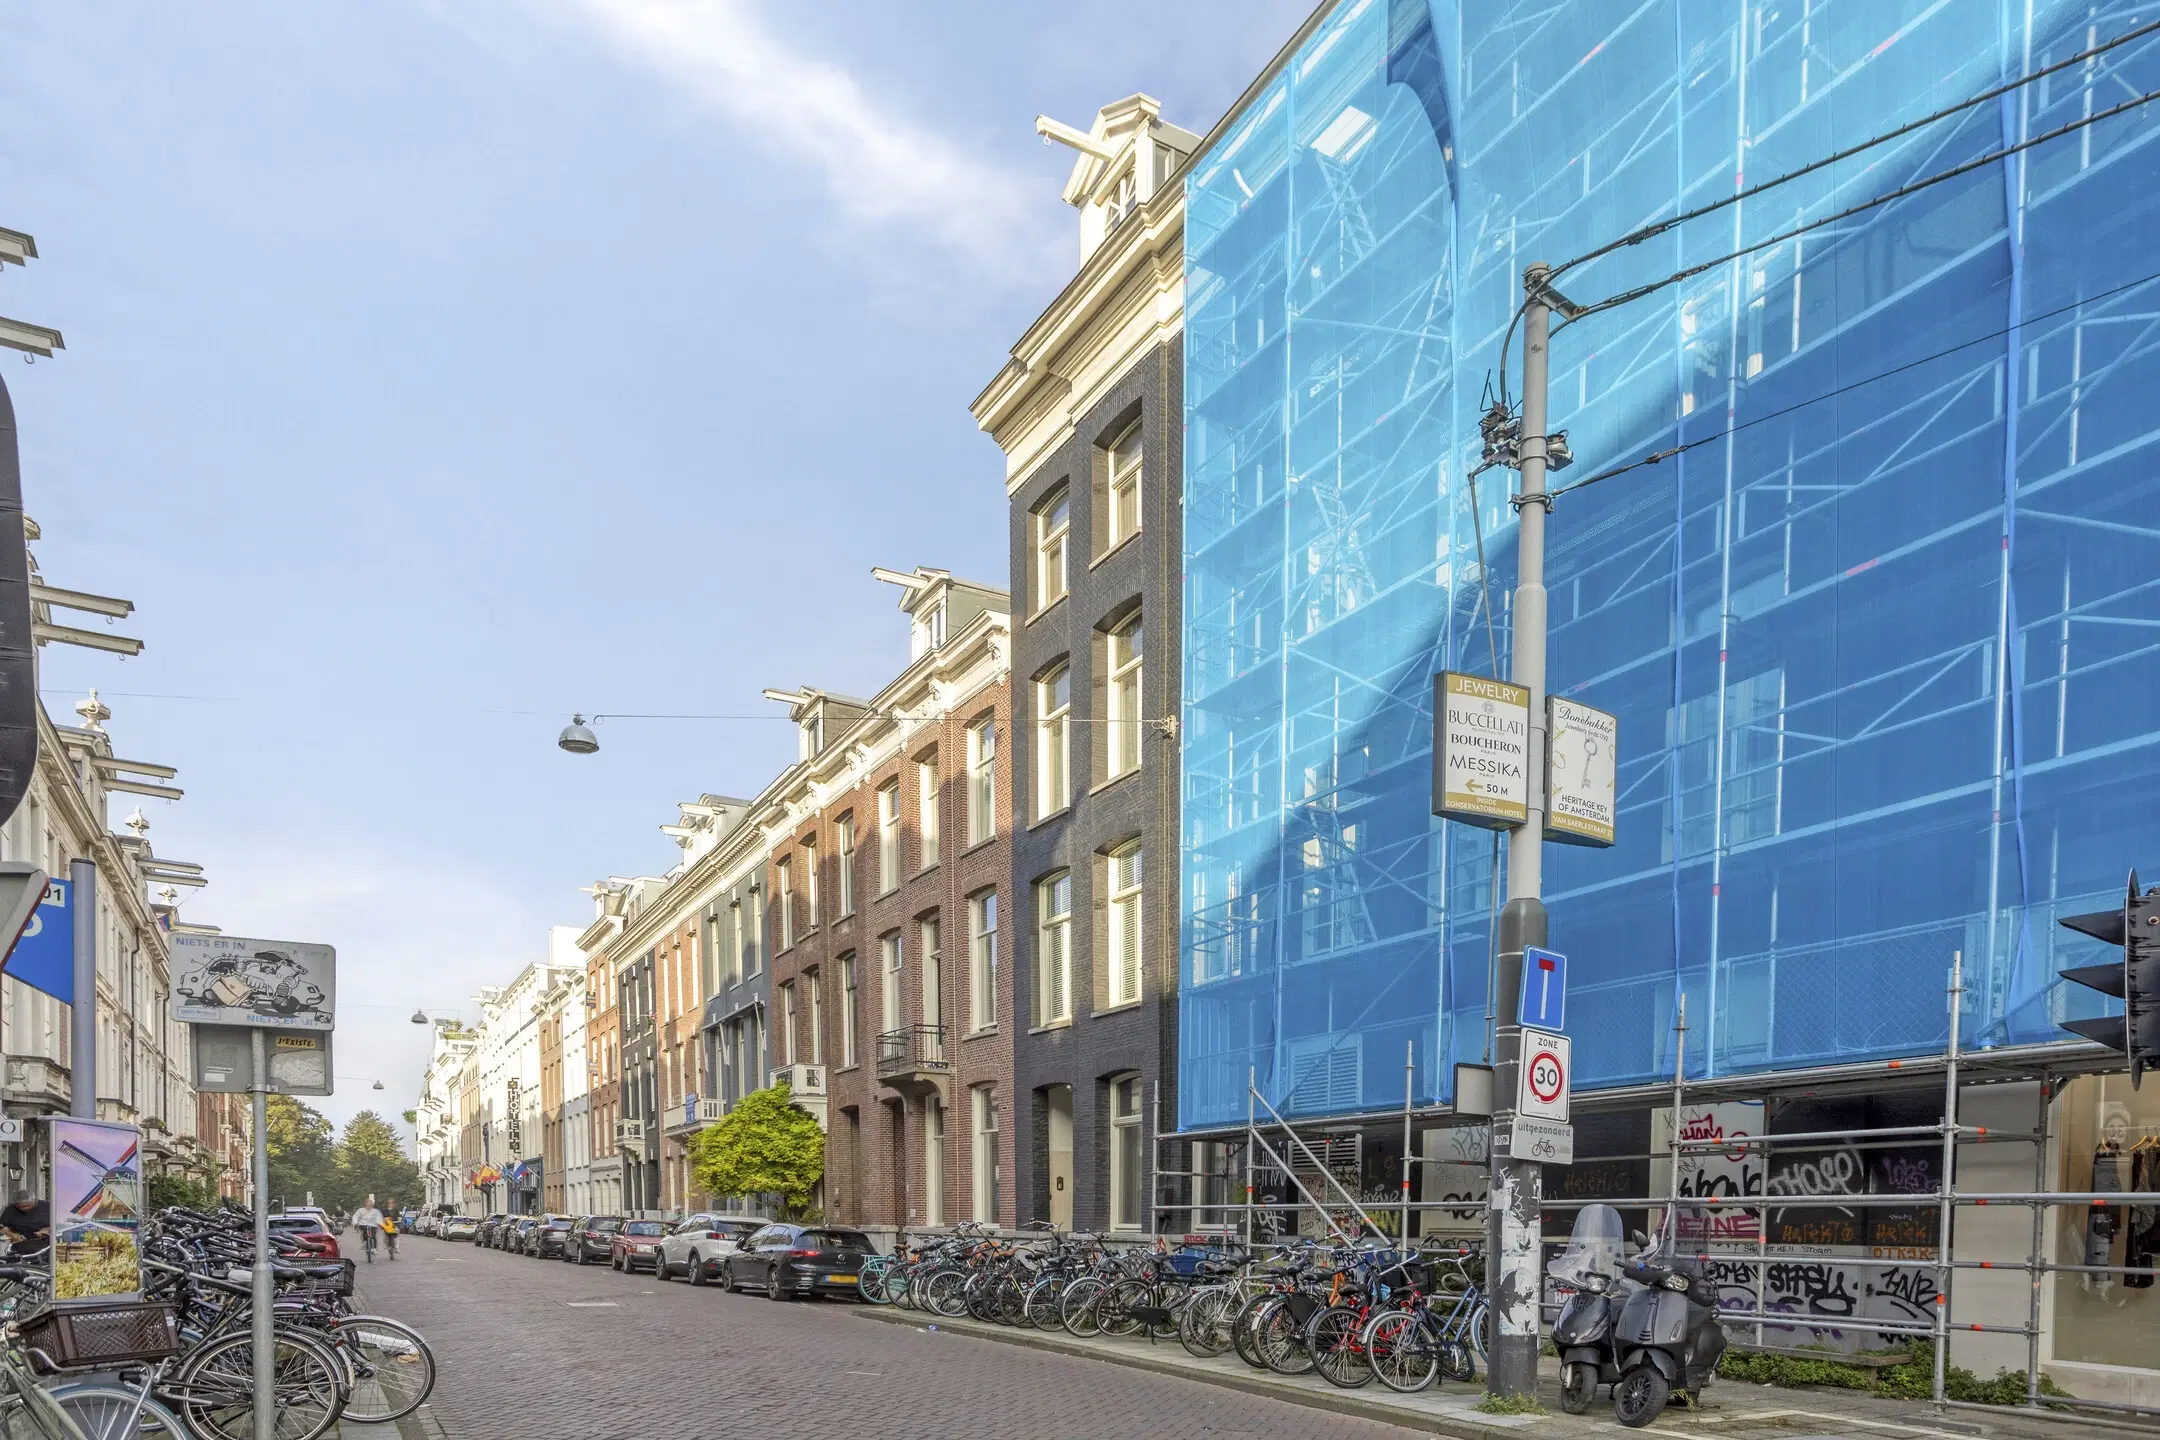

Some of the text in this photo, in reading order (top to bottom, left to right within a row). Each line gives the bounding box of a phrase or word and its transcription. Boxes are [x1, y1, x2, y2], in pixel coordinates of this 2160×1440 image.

[1456, 679, 1519, 702] JEWELRY
[1448, 709, 1524, 736] BUCCELLATI
[1558, 706, 1612, 733] Bonebakker
[1451, 734, 1521, 755] BOUCHERON
[1450, 753, 1521, 779] MESSIKA
[1486, 784, 1508, 795] 50 M
[1445, 800, 1523, 819] CONSERVATORIUM HOTEL
[1476, 796, 1497, 806] INSIDE
[1561, 794, 1608, 813] HERITAGE KEY
[1553, 815, 1566, 824] VAN
[1558, 803, 1610, 824] OF AMSTERDAM
[175, 937, 246, 950] NIETS ER IN
[247, 1015, 279, 1024] NIETS
[1537, 1037, 1559, 1050] ZONE
[1535, 1066, 1558, 1087] 30
[508, 1090, 520, 1140] HOTEL
[1518, 1122, 1571, 1138] uitgezonderd
[1802, 1246, 1832, 1254] STORM
